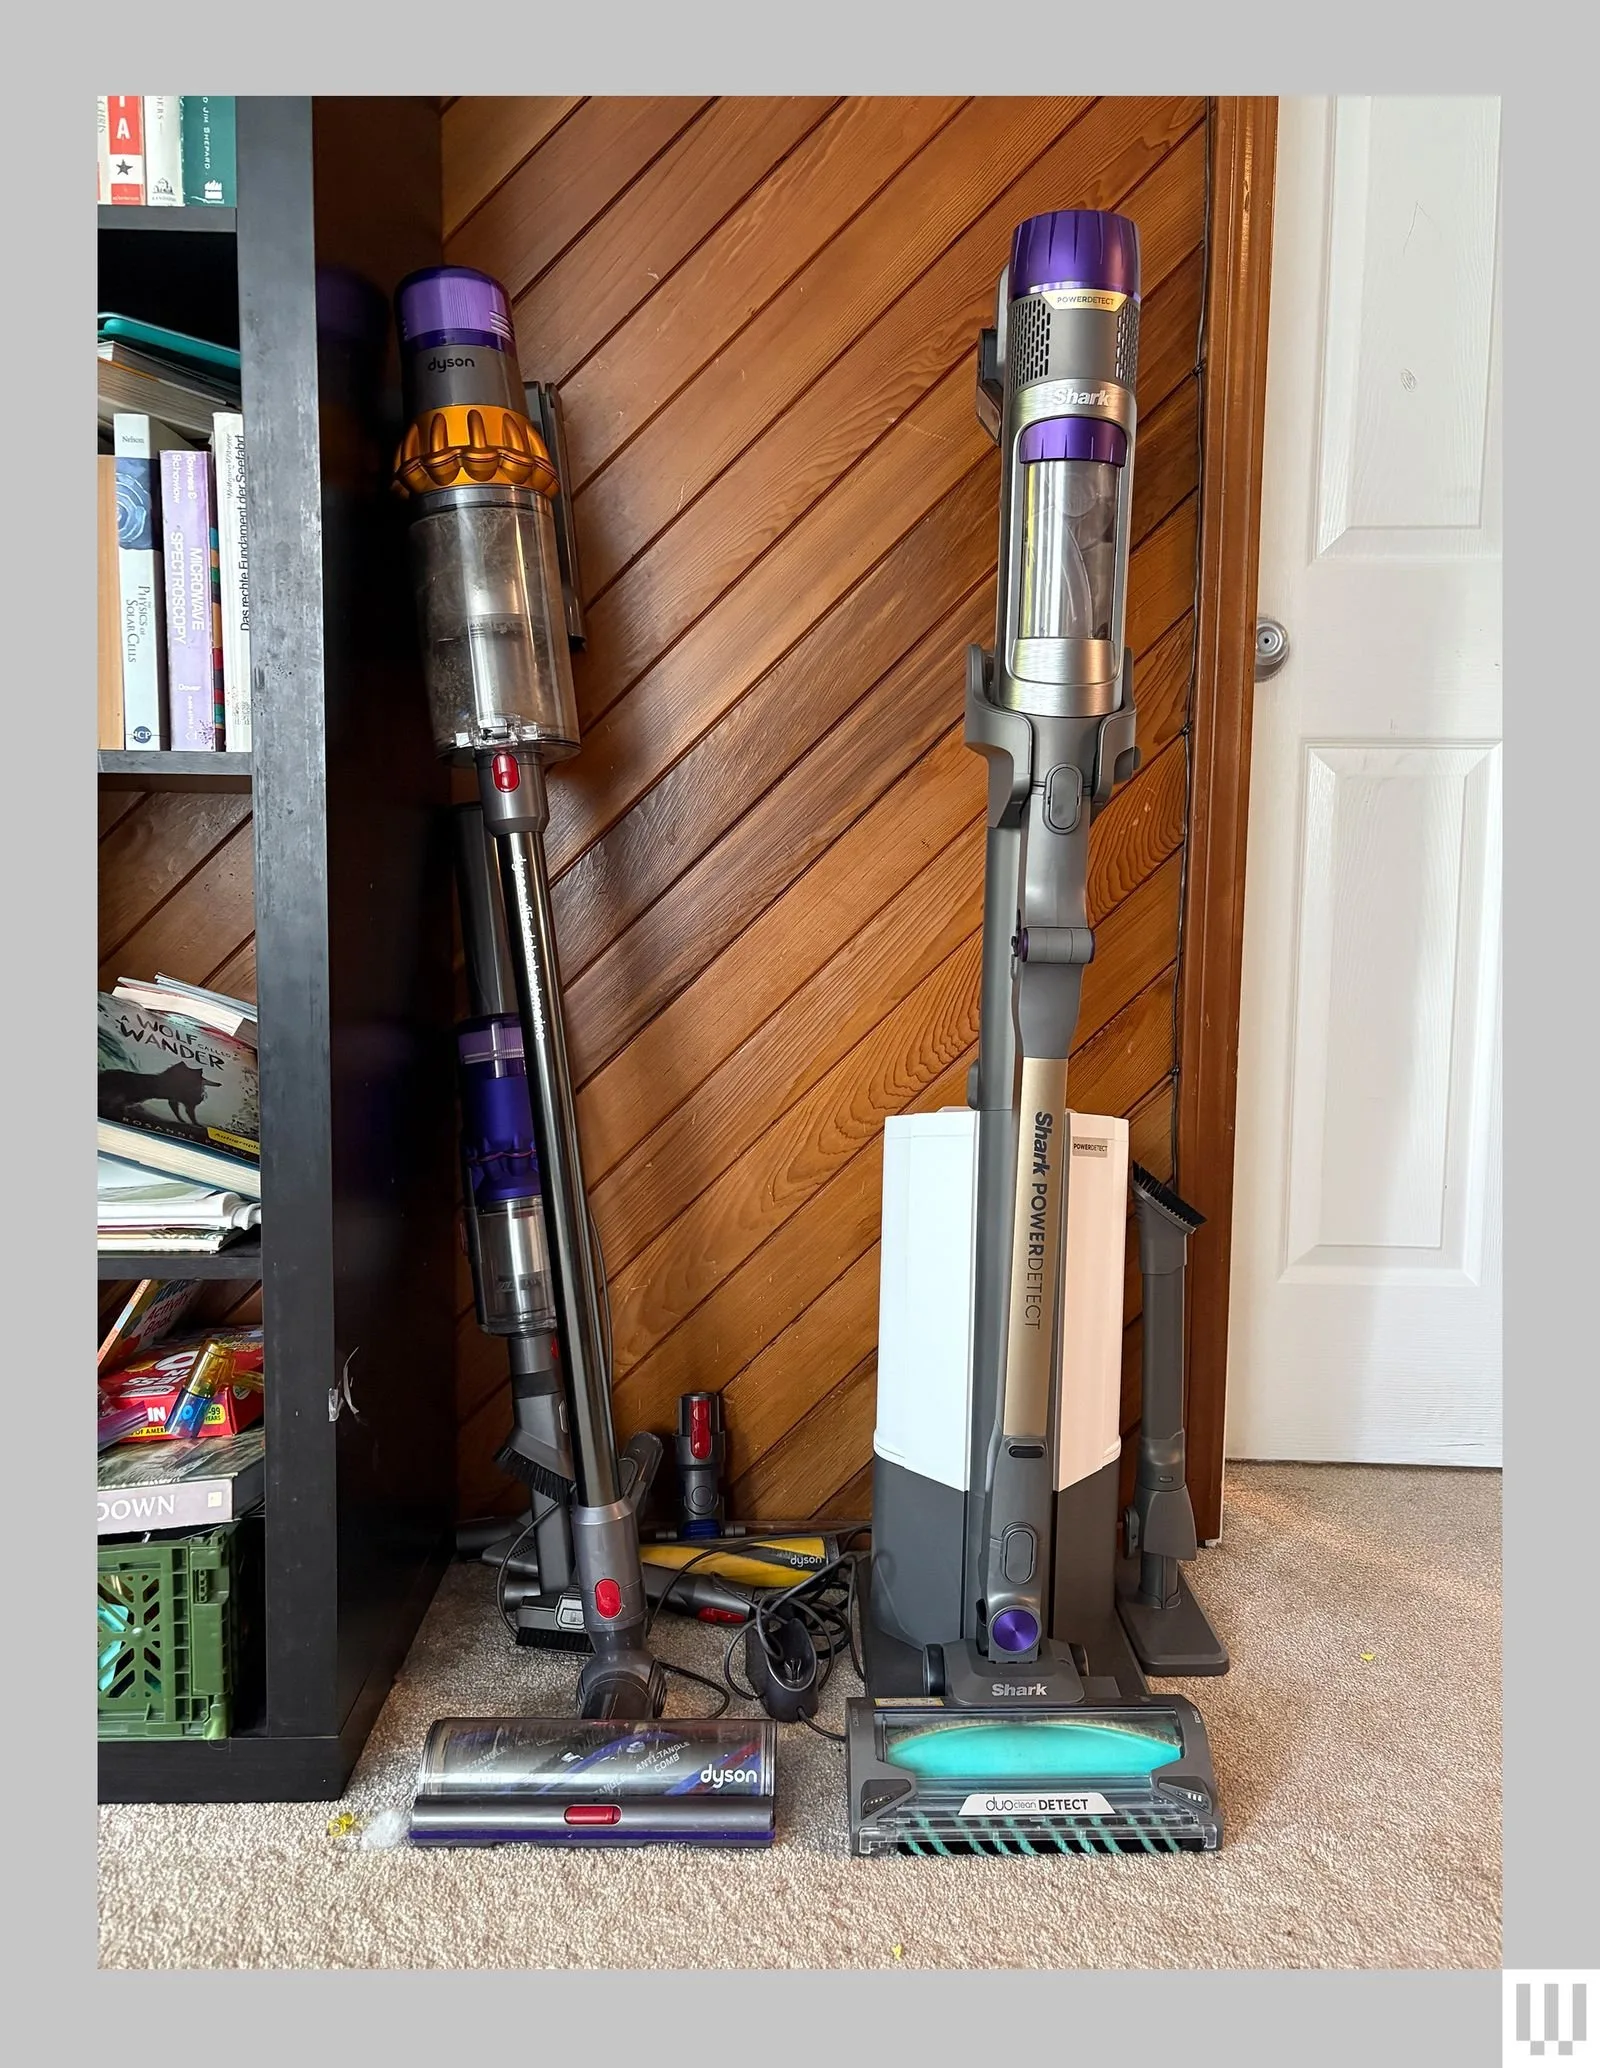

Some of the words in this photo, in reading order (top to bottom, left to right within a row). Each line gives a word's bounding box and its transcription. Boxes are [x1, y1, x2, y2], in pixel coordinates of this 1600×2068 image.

[203, 127, 211, 170] SHEPARD
[1057, 295, 1115, 306] POWERDETECT
[427, 356, 476, 373] dyson
[1053, 387, 1111, 407] Shark
[122, 436, 145, 444] Nelson
[171, 531, 187, 645] SPECTROSCOPY
[190, 547, 205, 631] MICROWAVE
[126, 599, 138, 632] SOLAR
[138, 585, 151, 627] PHYSICS
[240, 609, 250, 631] Das
[127, 633, 140, 663] CELLS
[136, 1013, 199, 1046] WOLF
[118, 1020, 226, 1072] WANDER
[1032, 1111, 1054, 1178] Shark
[1073, 1143, 1108, 1152] POWERDETECT
[1024, 1183, 1048, 1330] POWERDETECT
[147, 1406, 166, 1423] IN
[790, 1555, 822, 1568] dyson
[991, 1683, 1048, 1697] Shark
[635, 1740, 691, 1773] ANTI-TANGLE
[654, 1753, 681, 1773] COMB
[700, 1763, 758, 1789] dyson
[1038, 1798, 1089, 1811] DETECT
